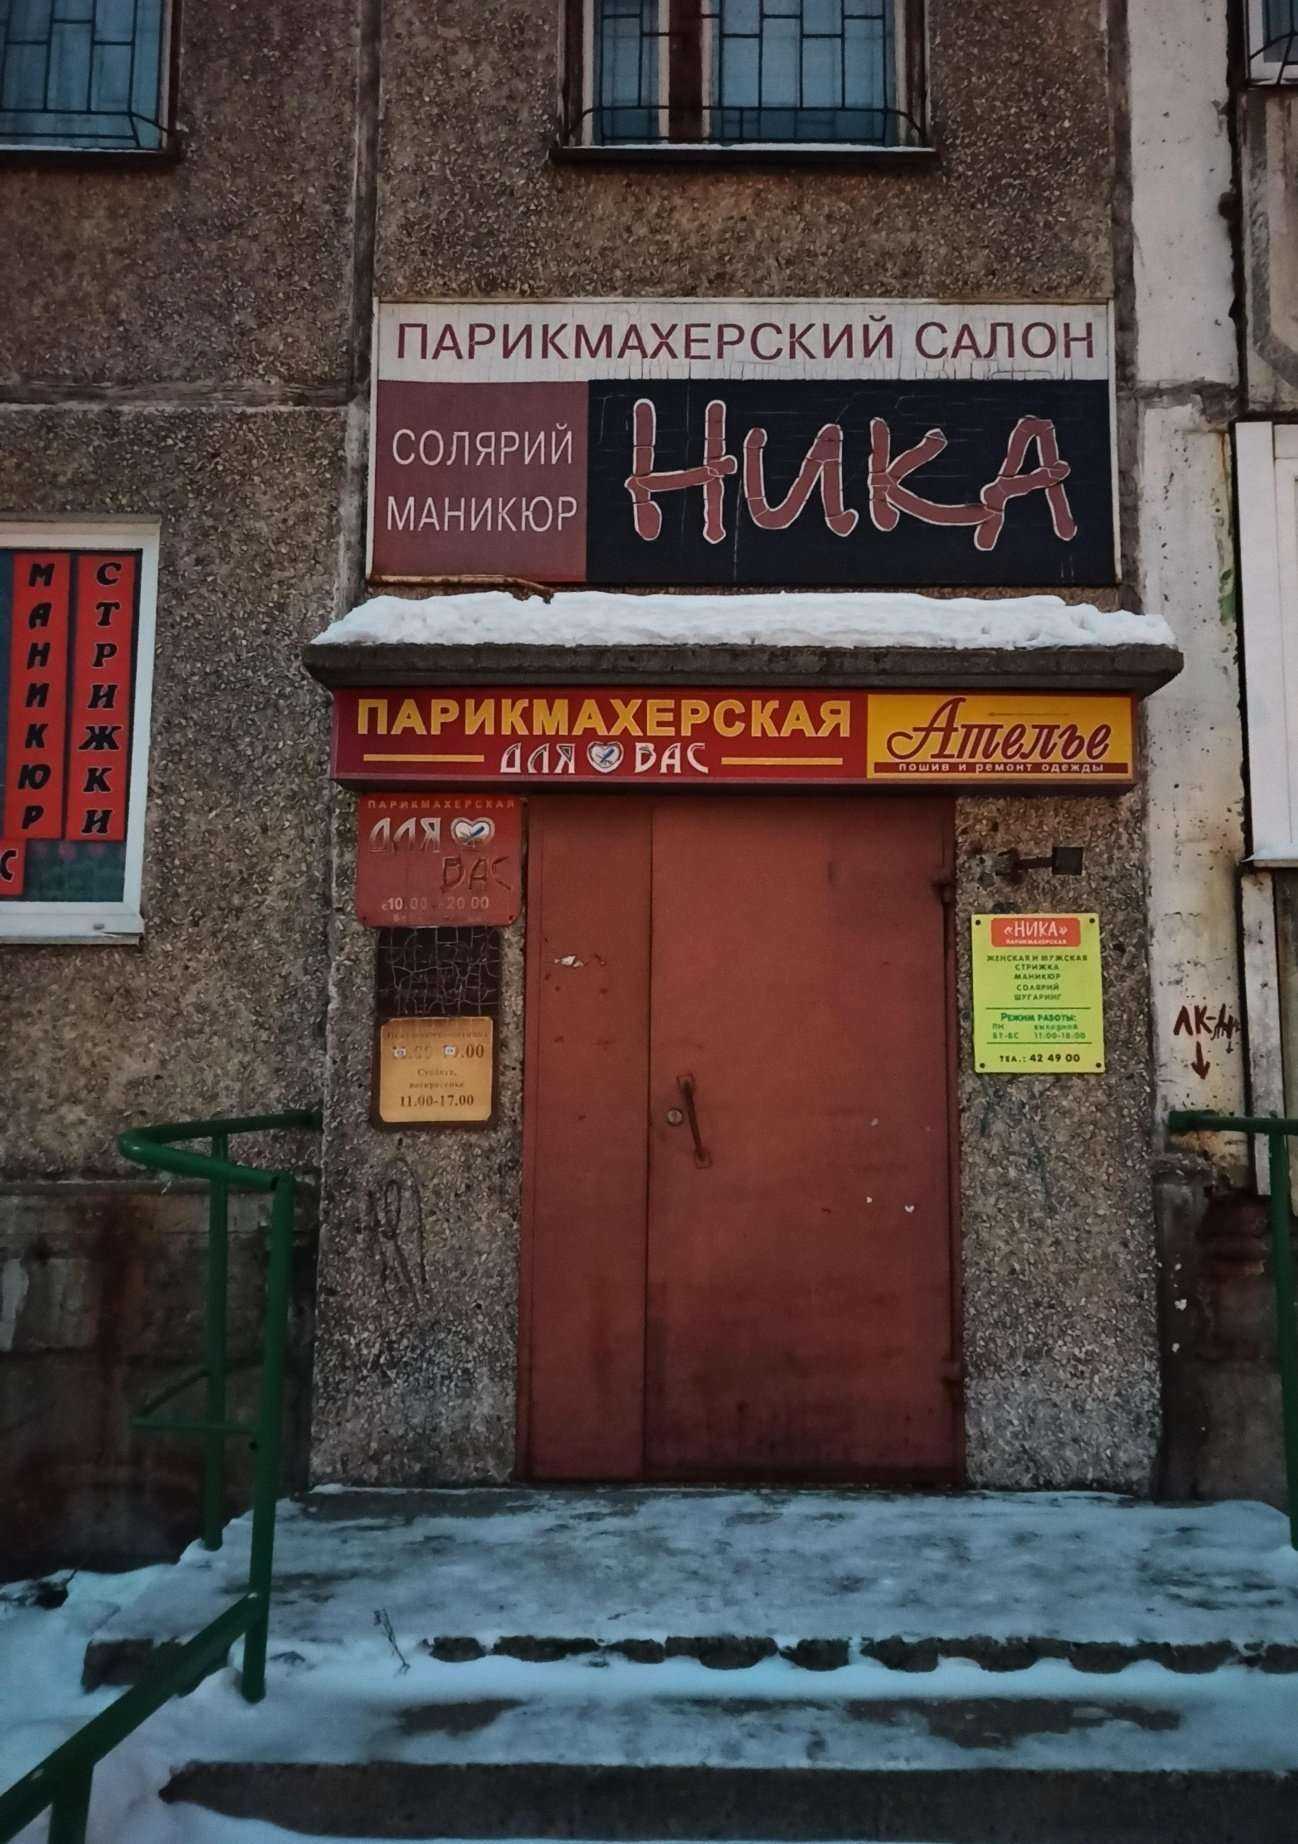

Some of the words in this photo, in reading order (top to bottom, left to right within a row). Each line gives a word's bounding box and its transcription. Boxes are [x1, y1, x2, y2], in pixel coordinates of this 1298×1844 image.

[397, 315, 894, 360] ПАРИКМАХЕРСКИЙ
[915, 321, 1094, 360] САЛОН
[391, 423, 574, 467] СОЛЯРИЙ
[624, 398, 1079, 552] НИКА
[386, 495, 579, 534] МАНИКЮР
[18, 562, 55, 830] МАНИКЮР
[78, 562, 122, 836] СТРИЖКИ
[357, 698, 851, 738] ПАРИКМАХЕРСКАЯ
[886, 696, 1112, 760] Ателье
[499, 741, 576, 775] ДЛЯ
[634, 743, 709, 774] ВАС
[898, 763, 950, 773] пошив
[958, 763, 967, 772] и
[975, 763, 1033, 775] ремонт
[1041, 763, 1104, 774] одежды
[1014, 963, 1060, 971] СТРИЖКА
[1029, 1054, 1043, 1063] 42
[1047, 1054, 1062, 1063] 49
[1065, 1054, 1081, 1063] 00
